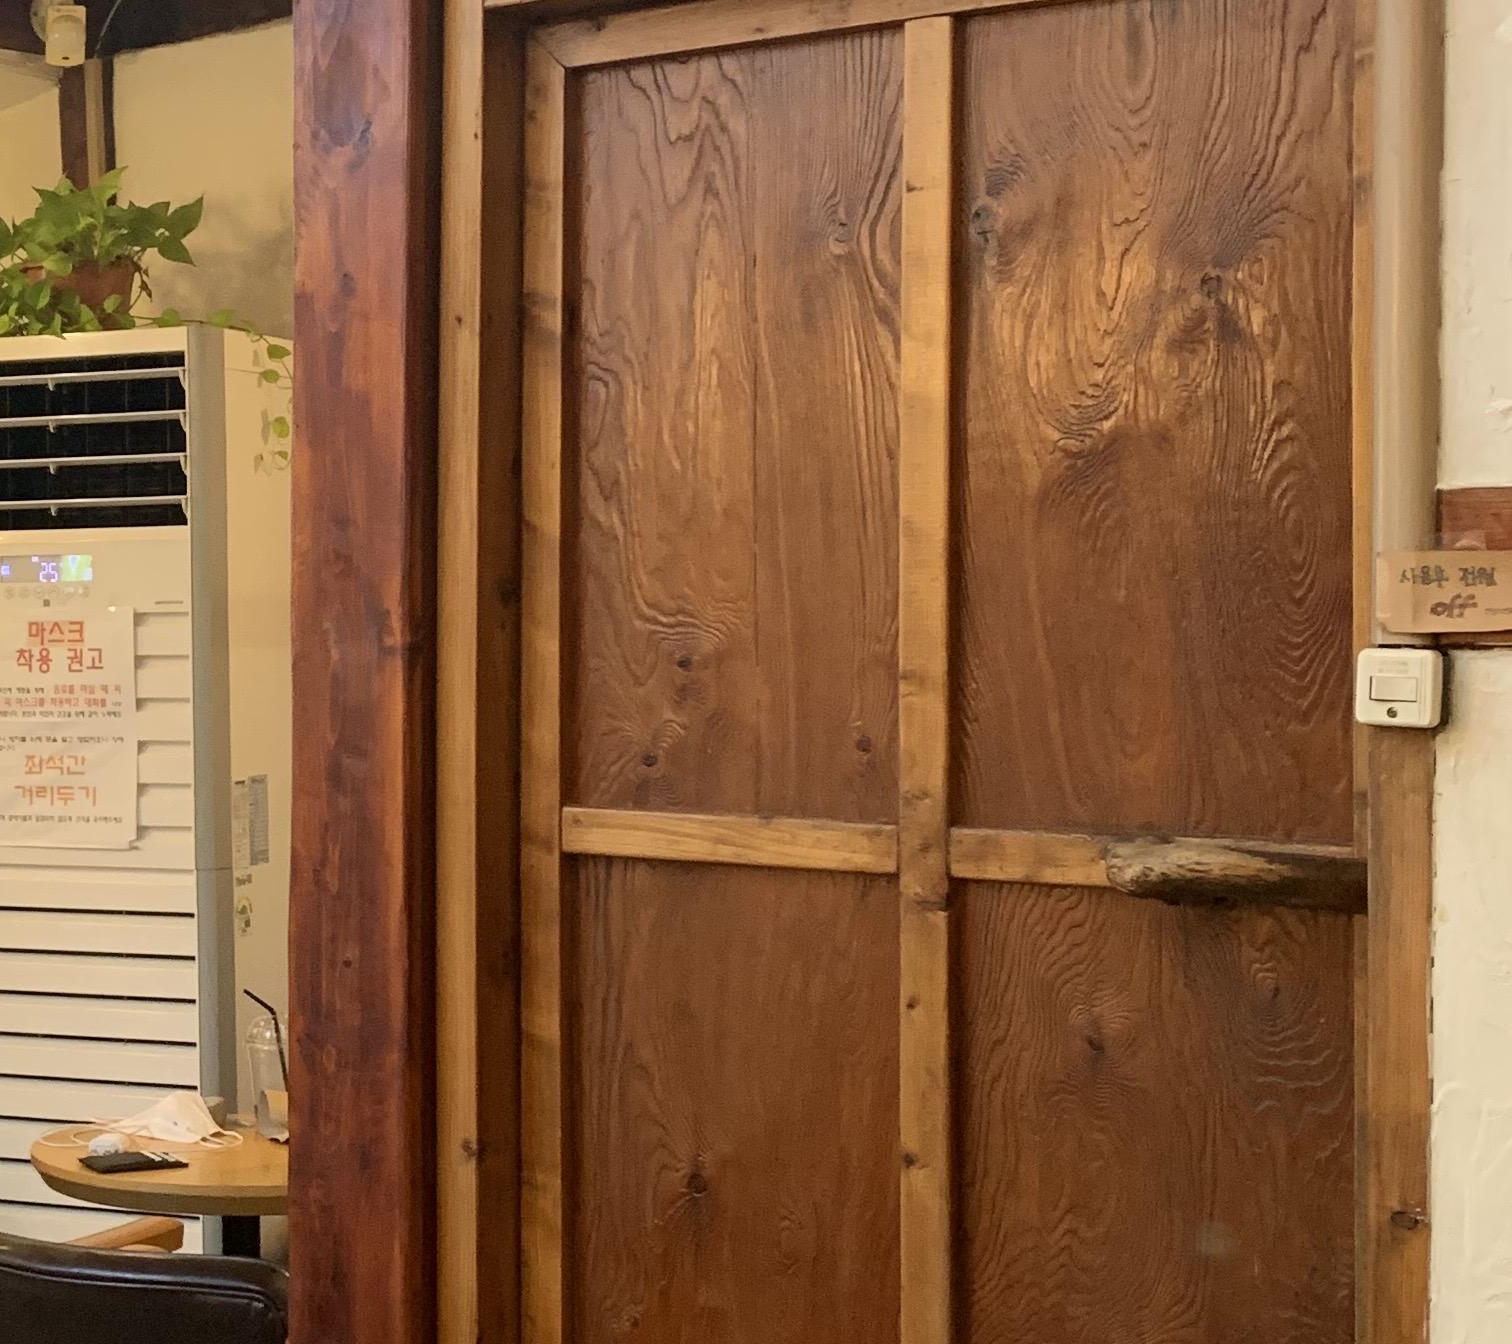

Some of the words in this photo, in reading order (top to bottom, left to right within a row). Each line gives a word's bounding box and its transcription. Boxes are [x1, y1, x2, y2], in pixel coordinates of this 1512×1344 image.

[39, 562, 59, 583] 25
[28, 620, 85, 646] 마스크
[16, 648, 53, 674] 착용
[66, 648, 104, 673] 권고
[24, 755, 87, 775] 좌석간
[13, 785, 97, 807] 거리두기
